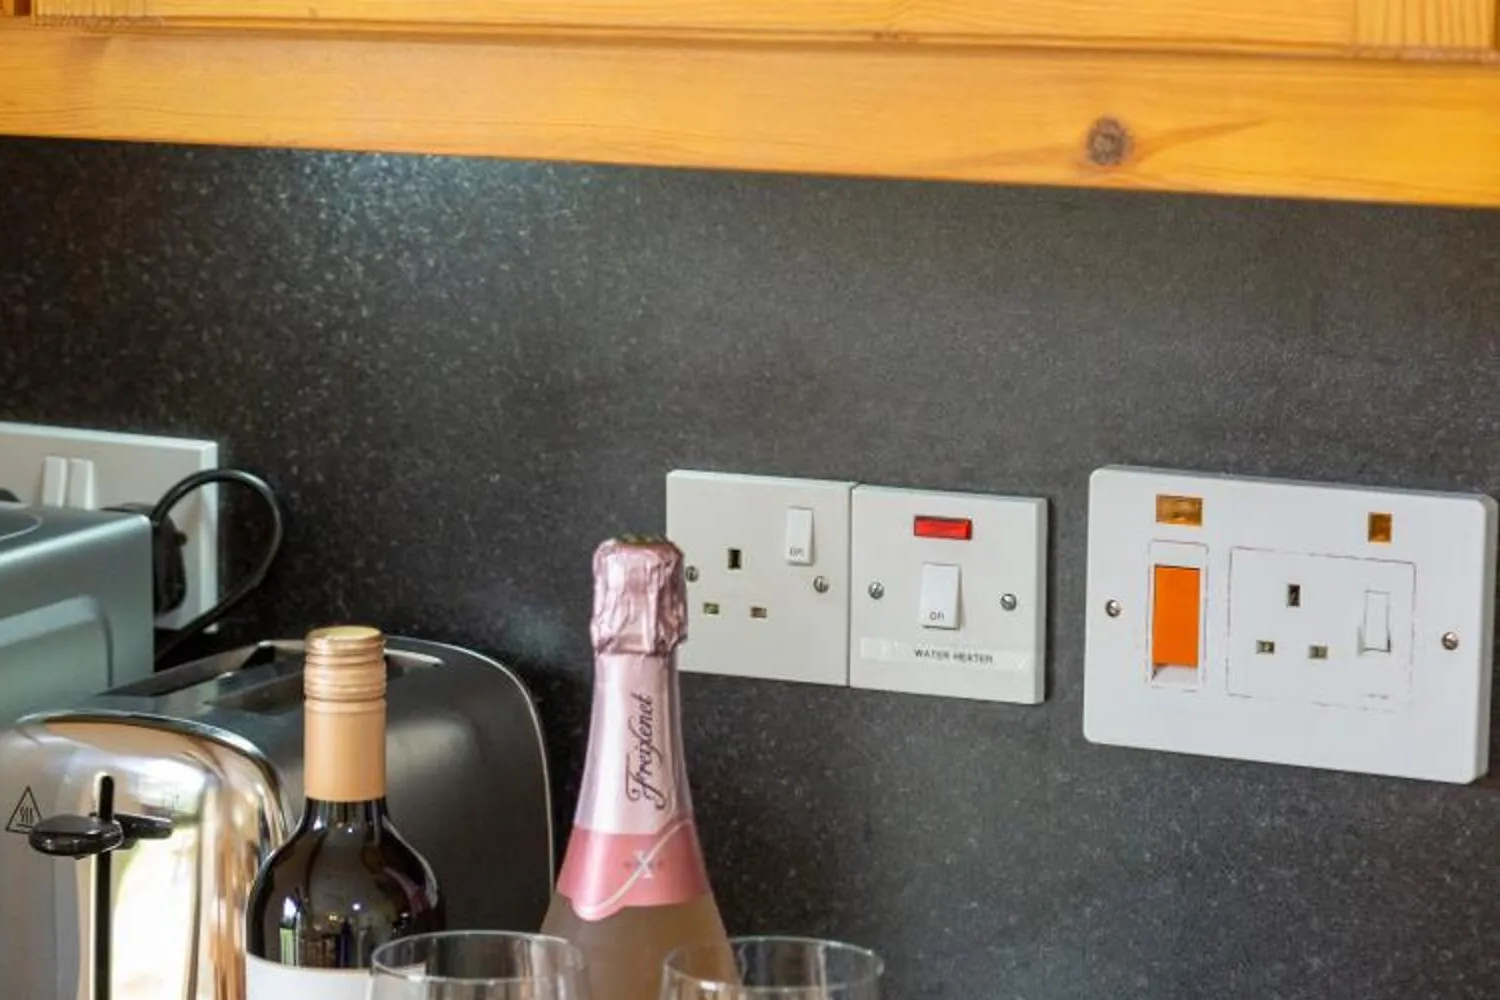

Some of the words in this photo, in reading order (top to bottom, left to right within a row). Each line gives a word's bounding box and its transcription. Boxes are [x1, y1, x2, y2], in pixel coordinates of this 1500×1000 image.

[914, 647, 949, 661] WATER
[953, 651, 993, 665] HEATER
[625, 692, 666, 810] Freixenet
